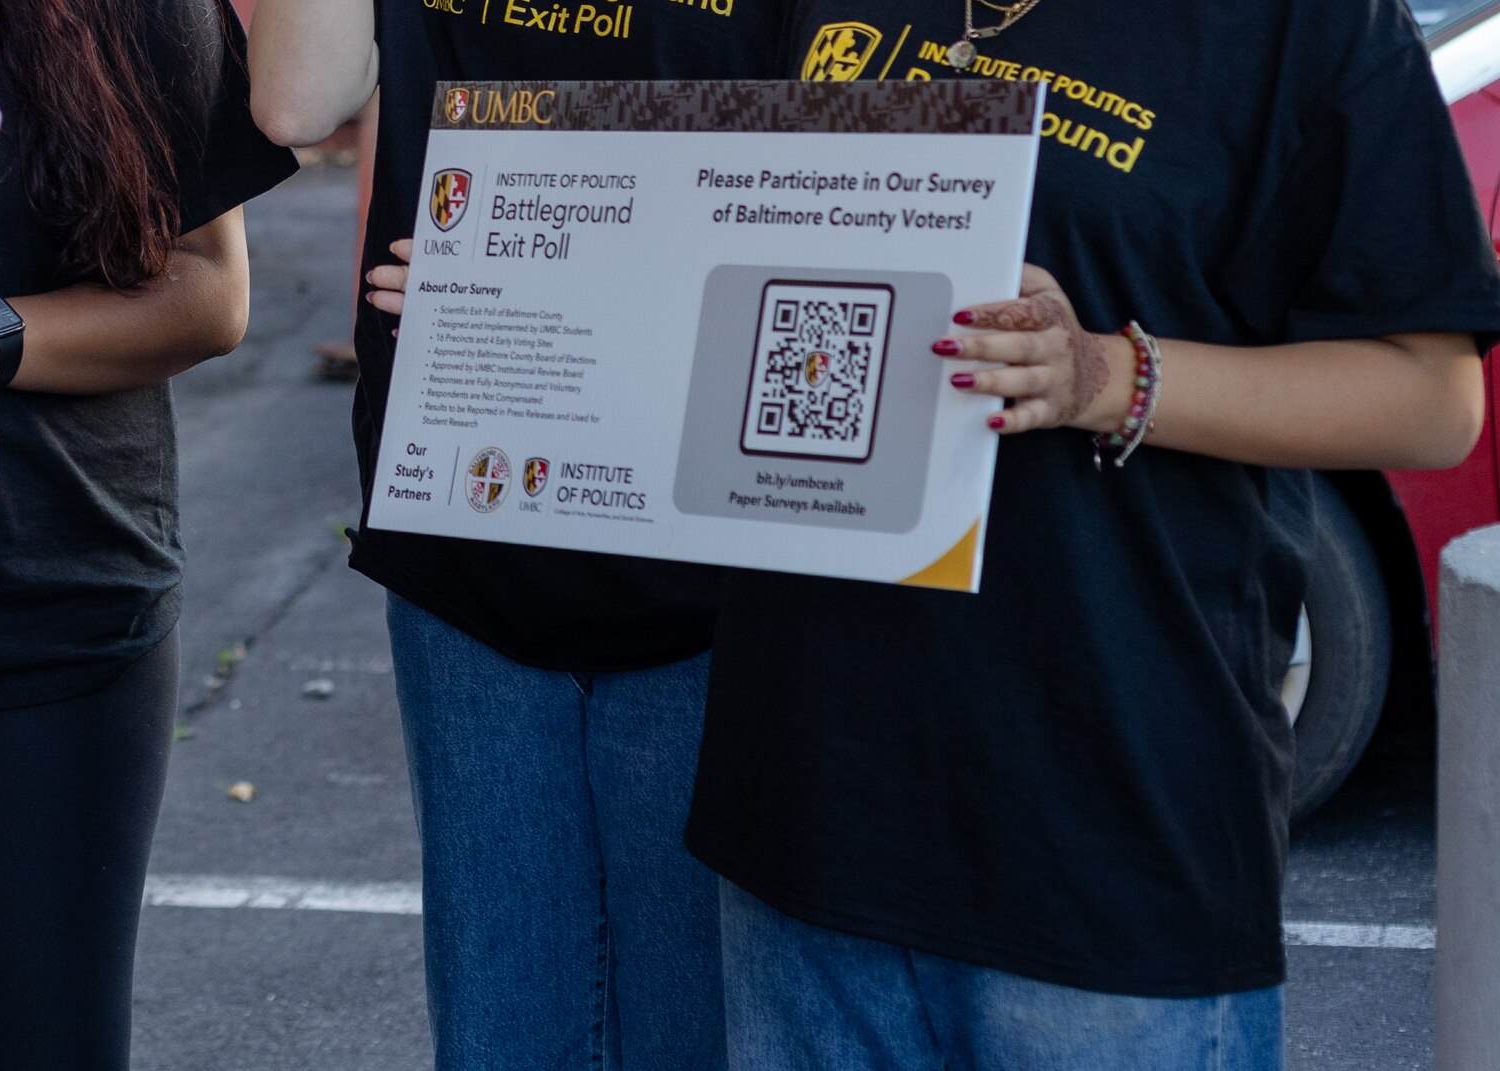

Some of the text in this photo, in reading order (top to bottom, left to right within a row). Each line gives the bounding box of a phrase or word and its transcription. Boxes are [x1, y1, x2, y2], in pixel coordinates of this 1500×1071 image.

[573, 4, 633, 39] Poll
[917, 40, 1021, 81] INSTUTE
[1051, 74, 1156, 130] POLITICS
[472, 89, 556, 124] UMBC
[496, 173, 637, 190] INSTITUTE OF POLITICS
[696, 169, 996, 200] Please Participate in Our Survey
[491, 195, 634, 230] Battleground
[712, 203, 972, 234] of Baltimore County Voters!
[424, 239, 462, 257] UMBC
[486, 232, 571, 260] Exit Poll
[418, 281, 503, 299] About Our Survey
[439, 305, 564, 322] Scientific Exit Poll of Baltimore County
[437, 319, 469, 331] Designed
[470, 321, 482, 330] and
[529, 324, 539, 335] by
[540, 326, 562, 335] UMBC
[563, 327, 593, 337] Students
[436, 333, 444, 342] 16
[445, 334, 474, 344] Precincts
[476, 336, 489, 345] and
[496, 336, 512, 348] Early
[514, 338, 535, 350] Voting
[537, 339, 553, 348] Sites
[433, 347, 597, 366] Approved by Baltimore County Board of Elections
[431, 360, 464, 373] Approved
[465, 362, 473, 373] by
[474, 363, 496, 373] UMBC
[538, 367, 561, 378] Review
[562, 368, 584, 379] Board
[429, 374, 463, 387] Responses
[476, 377, 492, 388] Fully
[494, 379, 533, 391] Anonymous
[534, 382, 548, 391] and
[549, 382, 582, 395] Voluntary
[426, 388, 543, 405] Respondents are Not Compensated
[422, 416, 479, 428] Student Research
[424, 402, 447, 413] Results
[448, 403, 455, 413] to
[457, 403, 465, 414] be
[467, 405, 498, 417] Reported
[507, 408, 524, 418] Press
[526, 409, 556, 421] Releases
[557, 412, 570, 421] and
[571, 413, 589, 423] Used
[406, 442, 427, 456] Our
[395, 463, 435, 482] Study's
[560, 462, 634, 485] INSTITUTE
[756, 471, 844, 492] bit.ly/umbcexit
[388, 485, 432, 502] Partners
[557, 486, 647, 510] OF POLITICS
[519, 500, 543, 513] UMBC
[729, 491, 867, 516] Paper Surveys Available
